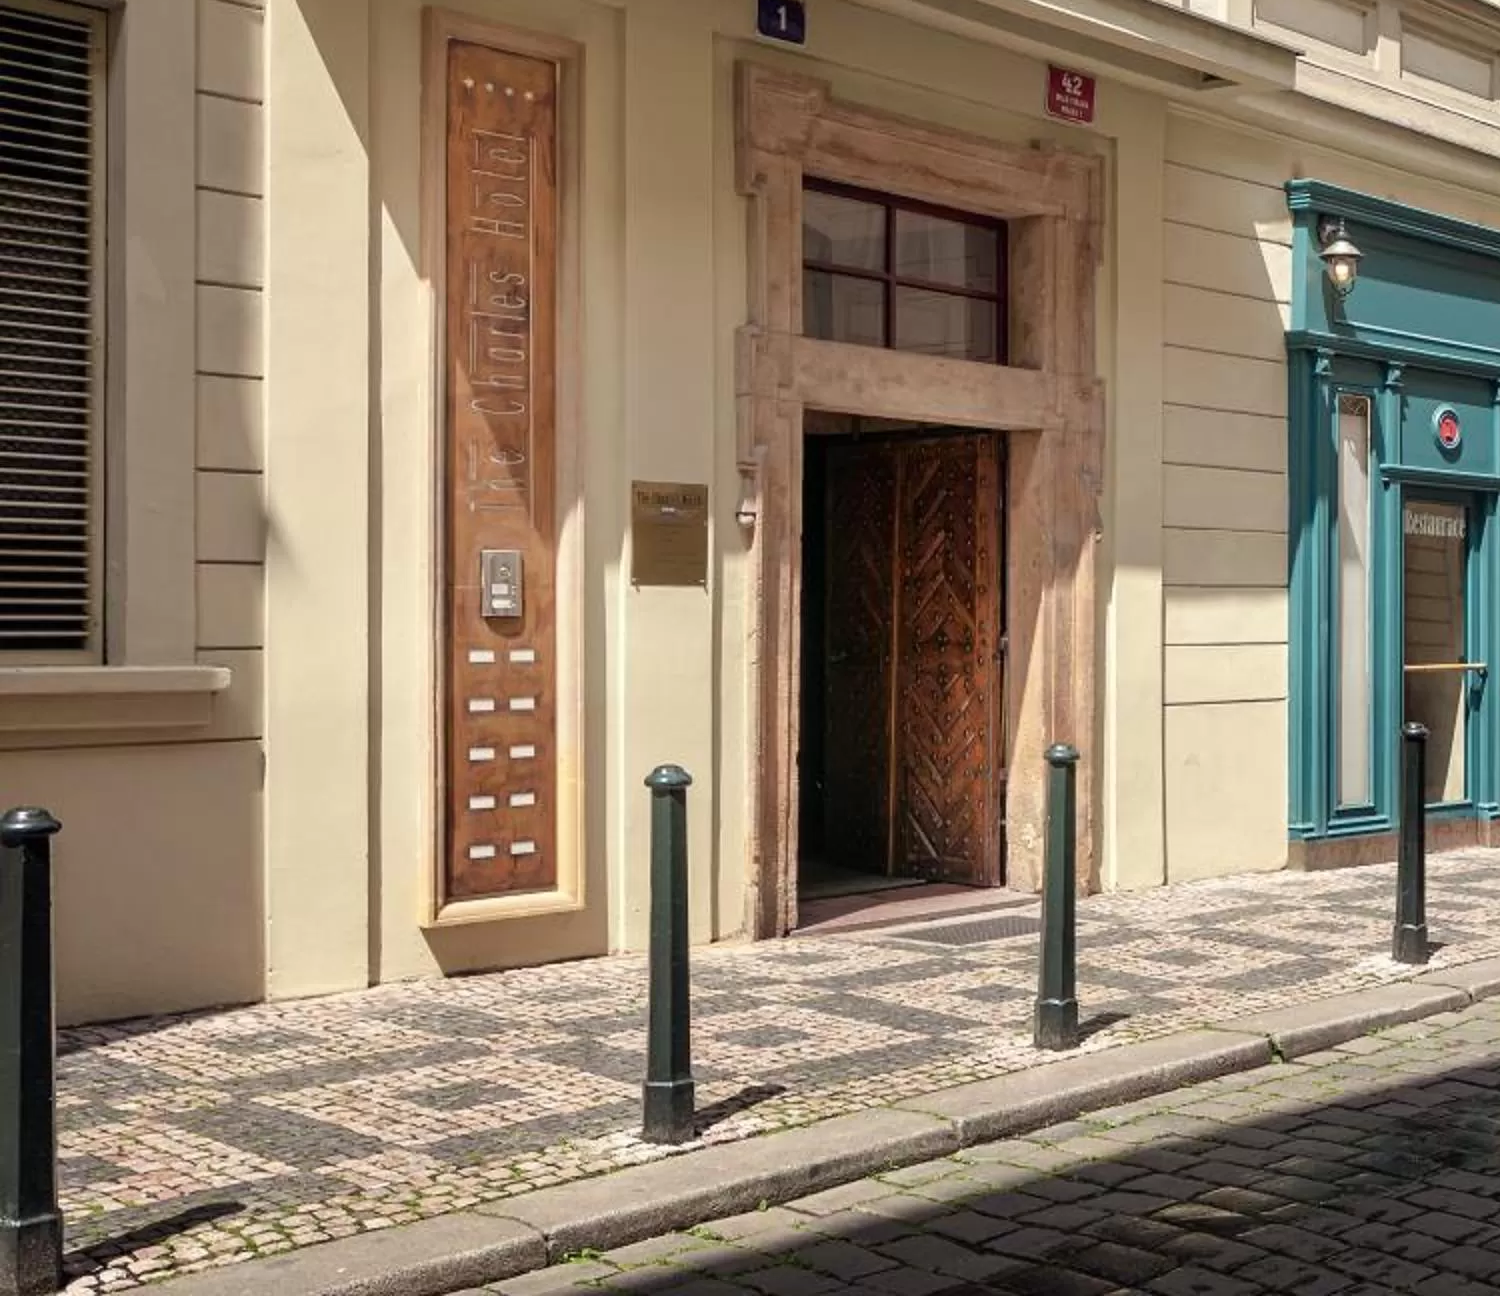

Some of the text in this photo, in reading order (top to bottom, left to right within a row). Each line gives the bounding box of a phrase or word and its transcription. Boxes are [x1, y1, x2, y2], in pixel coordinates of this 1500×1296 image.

[777, 5, 787, 31] 1
[1061, 73, 1083, 95] 42
[470, 127, 526, 239] Hotel
[470, 270, 526, 415] Charles
